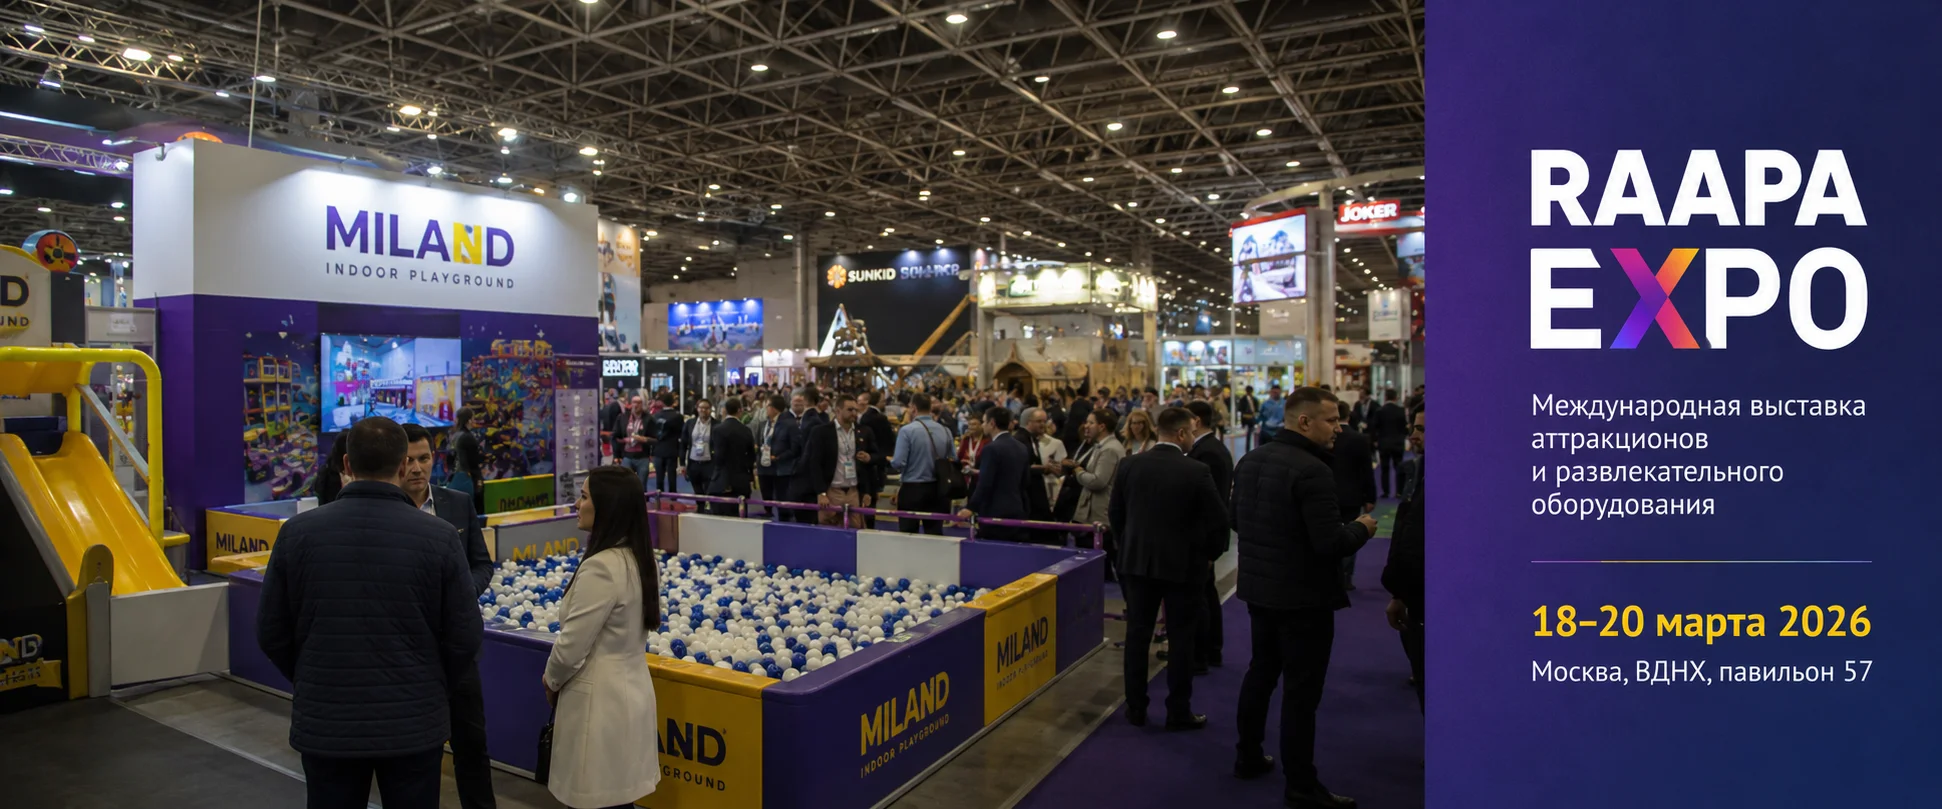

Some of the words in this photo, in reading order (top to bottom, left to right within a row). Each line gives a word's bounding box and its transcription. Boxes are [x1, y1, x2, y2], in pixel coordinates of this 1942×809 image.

[1340, 203, 1397, 223] JOKER
[326, 205, 515, 267] MILAND
[326, 262, 398, 279] INDOOR
[409, 269, 514, 289] PLAYGROUND
[847, 268, 897, 283] SUNKID
[216, 532, 270, 555] MILAND
[997, 616, 1048, 674] MILAND
[861, 671, 950, 756] MILAND
[659, 763, 726, 792] GROUND
[860, 747, 896, 779] INDOOR
